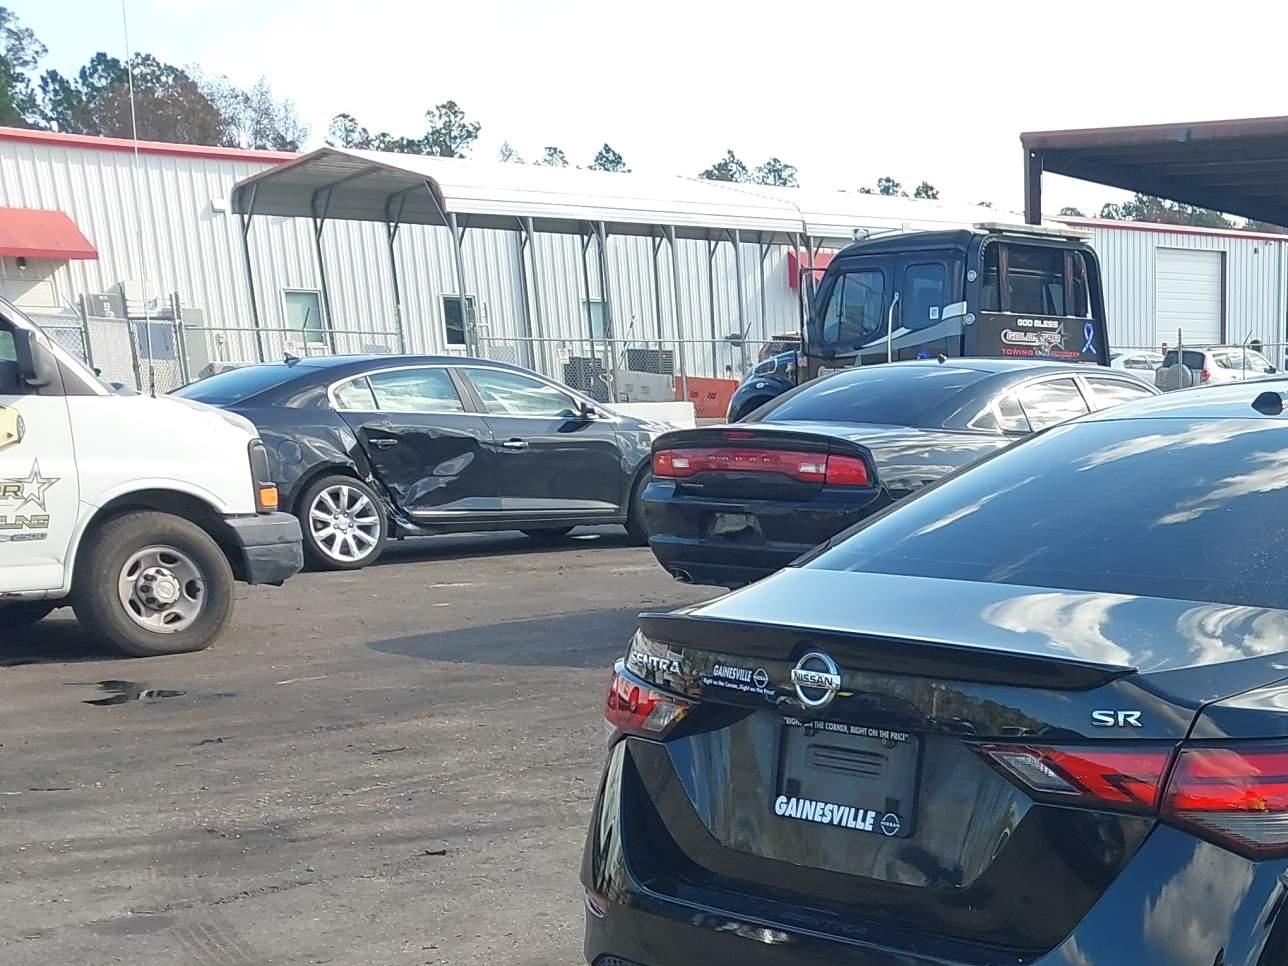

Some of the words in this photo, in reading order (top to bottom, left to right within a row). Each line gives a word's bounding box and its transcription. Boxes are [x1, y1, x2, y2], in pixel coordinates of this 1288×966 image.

[1017, 319, 1033, 327] GOD
[1001, 348, 1034, 357] TOWING
[631, 651, 682, 676] SENTRA
[713, 664, 752, 683] GAINESVILLE
[794, 670, 833, 686] NISSAN
[1091, 710, 1143, 727] SR
[850, 726, 868, 736] RIGHT
[868, 728, 878, 737] ON
[879, 730, 890, 739] THE
[775, 795, 876, 831] GAINESVILLE
